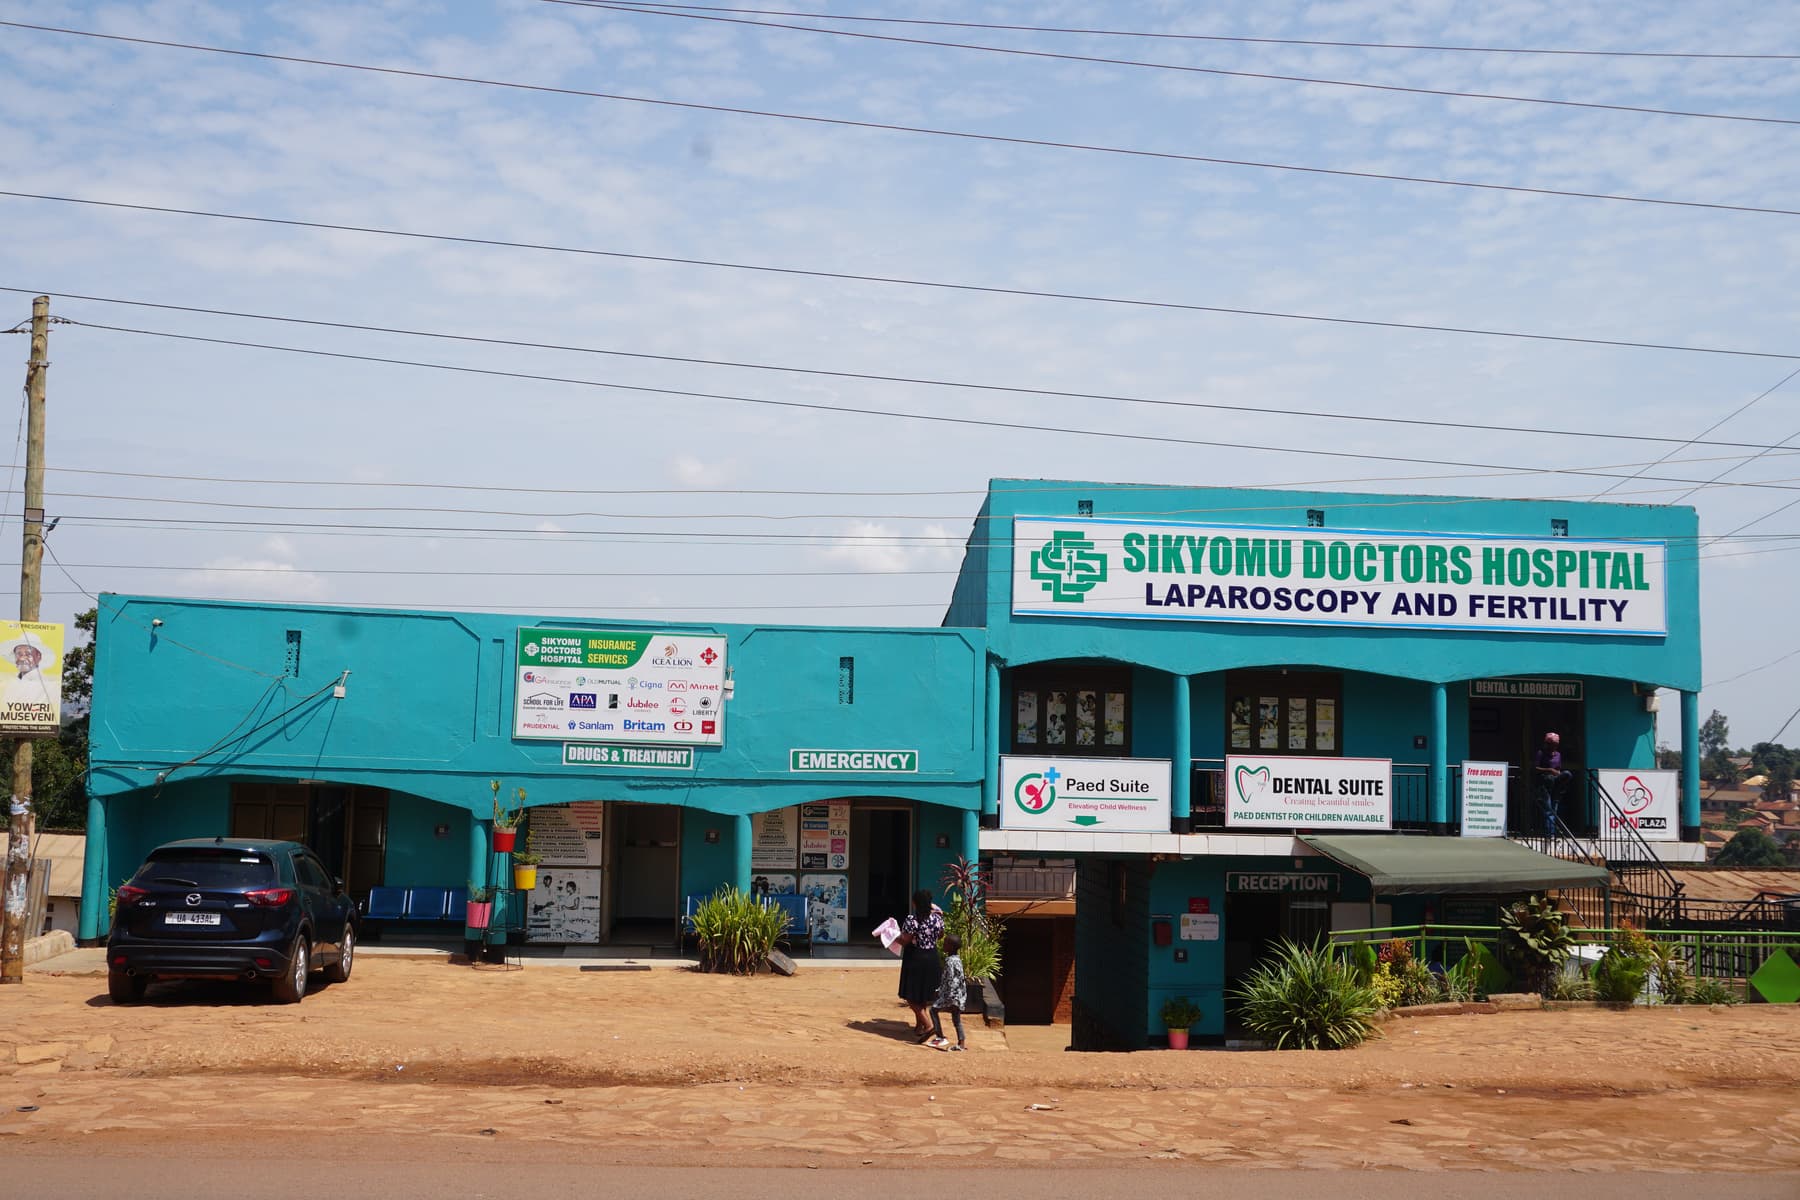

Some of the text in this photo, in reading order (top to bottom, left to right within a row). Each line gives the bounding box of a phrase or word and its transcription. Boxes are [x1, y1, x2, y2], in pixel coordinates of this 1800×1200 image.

[1123, 532, 1650, 590] SIKYOMU DOCTORS HOSPITAL
[1146, 582, 1629, 622] LAPAROSCOPY AND FERTILITY
[542, 637, 581, 646] SIKYOMU
[588, 640, 636, 651] INSURANCE
[541, 646, 582, 654] DOCTORS
[540, 655, 582, 664] HOSPITAL
[588, 653, 628, 664] SERVICES
[640, 680, 663, 689] Cigna
[1476, 681, 1576, 696] DENTAL & LABORATORY
[572, 694, 594, 705] APA
[627, 697, 659, 708] Jubilee
[0, 712, 54, 721] MUSEVENI
[579, 721, 614, 730] Sanlam
[624, 720, 665, 730] Britam
[568, 746, 688, 764] DRUGS & TREATMENT
[799, 753, 910, 769] EMERGENCY
[1479, 768, 1503, 776] services
[1066, 778, 1150, 793] Paed Suite
[1272, 777, 1384, 796] DENTAL SUITE
[1284, 797, 1316, 806] Creating
[1317, 797, 1349, 806] beautiful
[1255, 812, 1287, 820] DENTIST
[1305, 813, 1342, 821] CHILDREN
[1343, 814, 1384, 822] AVAILABLE
[1238, 876, 1328, 890] RECEPTION
